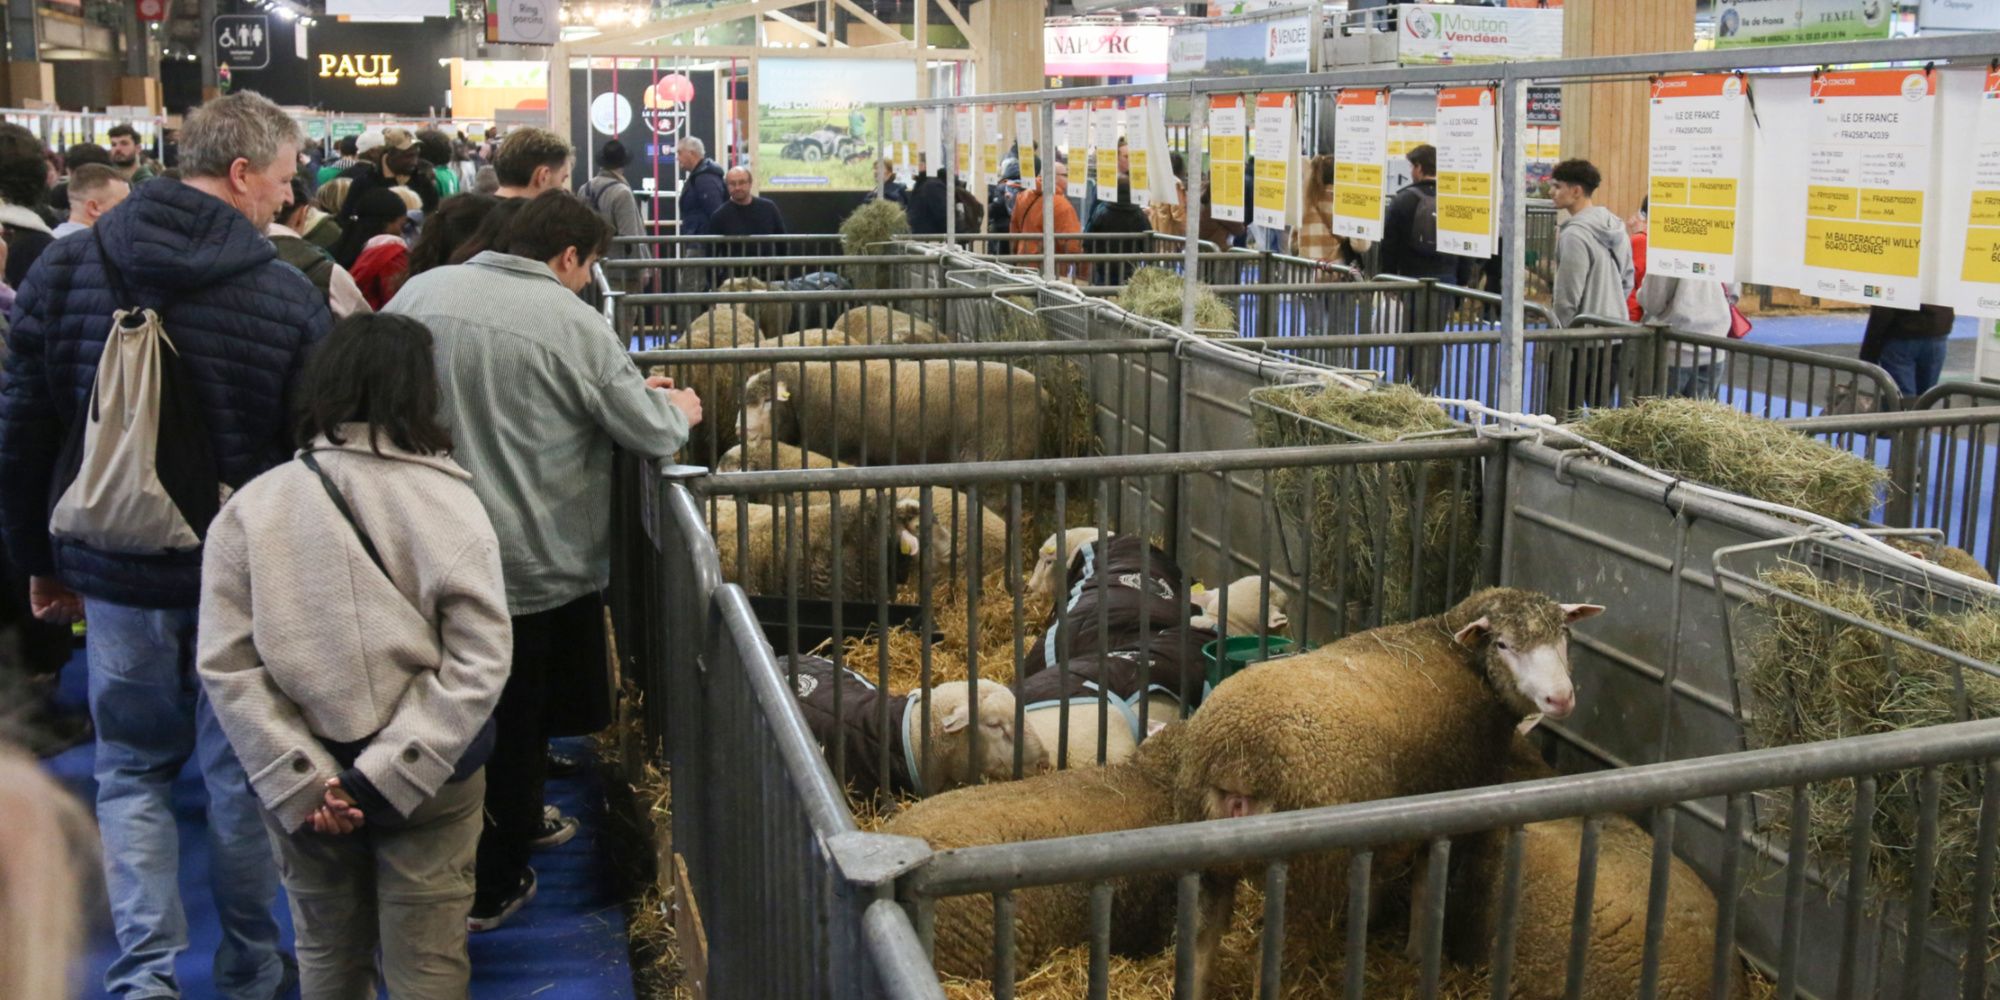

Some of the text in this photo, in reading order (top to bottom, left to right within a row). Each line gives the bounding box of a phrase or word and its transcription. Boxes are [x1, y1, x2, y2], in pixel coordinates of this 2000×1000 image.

[519, 4, 538, 17] Ring
[513, 15, 544, 25] porcins
[1444, 13, 1508, 32] Mouton
[1763, 16, 1784, 25] France
[1820, 12, 1855, 23] TEXEL
[1278, 25, 1306, 44] VENDÉE
[1445, 31, 1508, 44] Vendéen
[319, 54, 399, 77] PAUL
[1675, 112, 1683, 120] ILE
[1684, 111, 1692, 120] DE
[1694, 111, 1720, 120] FRANCE
[1840, 113, 1851, 123] ILE
[1852, 113, 1863, 123] DE
[1865, 113, 1898, 123] FRANCE
[1664, 225, 1708, 235] 60400 CAISNES
[1671, 217, 1713, 228] BALDERACCHI
[1714, 220, 1735, 230] WILLY
[1825, 232, 1920, 248] M BALDERACCHI WILLY
[1825, 241, 1884, 255] 60400 CAISNES
